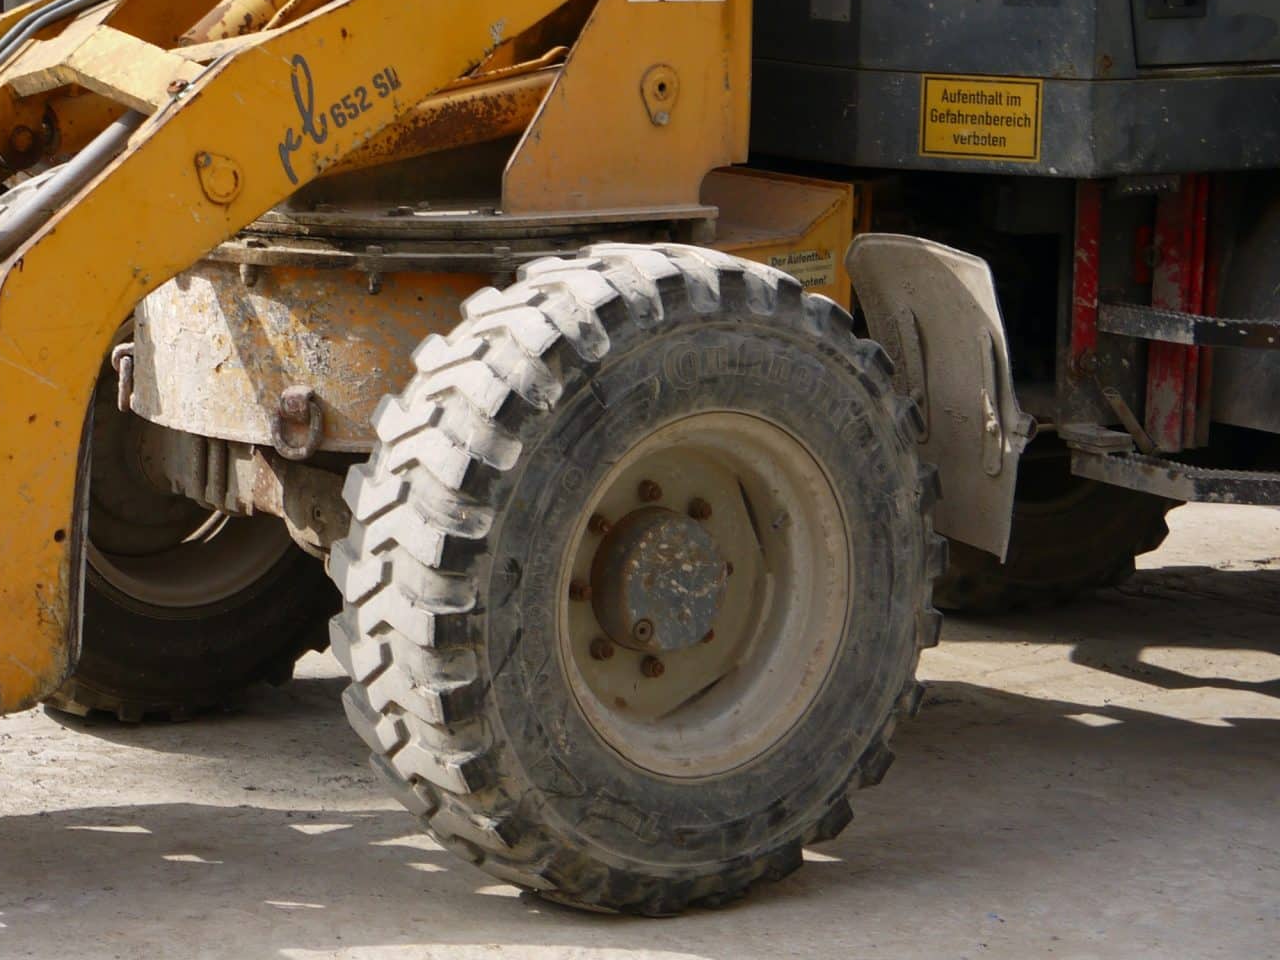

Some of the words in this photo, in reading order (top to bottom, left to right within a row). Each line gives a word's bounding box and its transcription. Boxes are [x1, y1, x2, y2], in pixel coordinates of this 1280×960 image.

[329, 85, 374, 128] 652
[941, 87, 1004, 106] Aufenthalt
[1006, 91, 1022, 107] im
[930, 108, 1032, 128] Gefahrenbereich
[953, 131, 1007, 148] verboten
